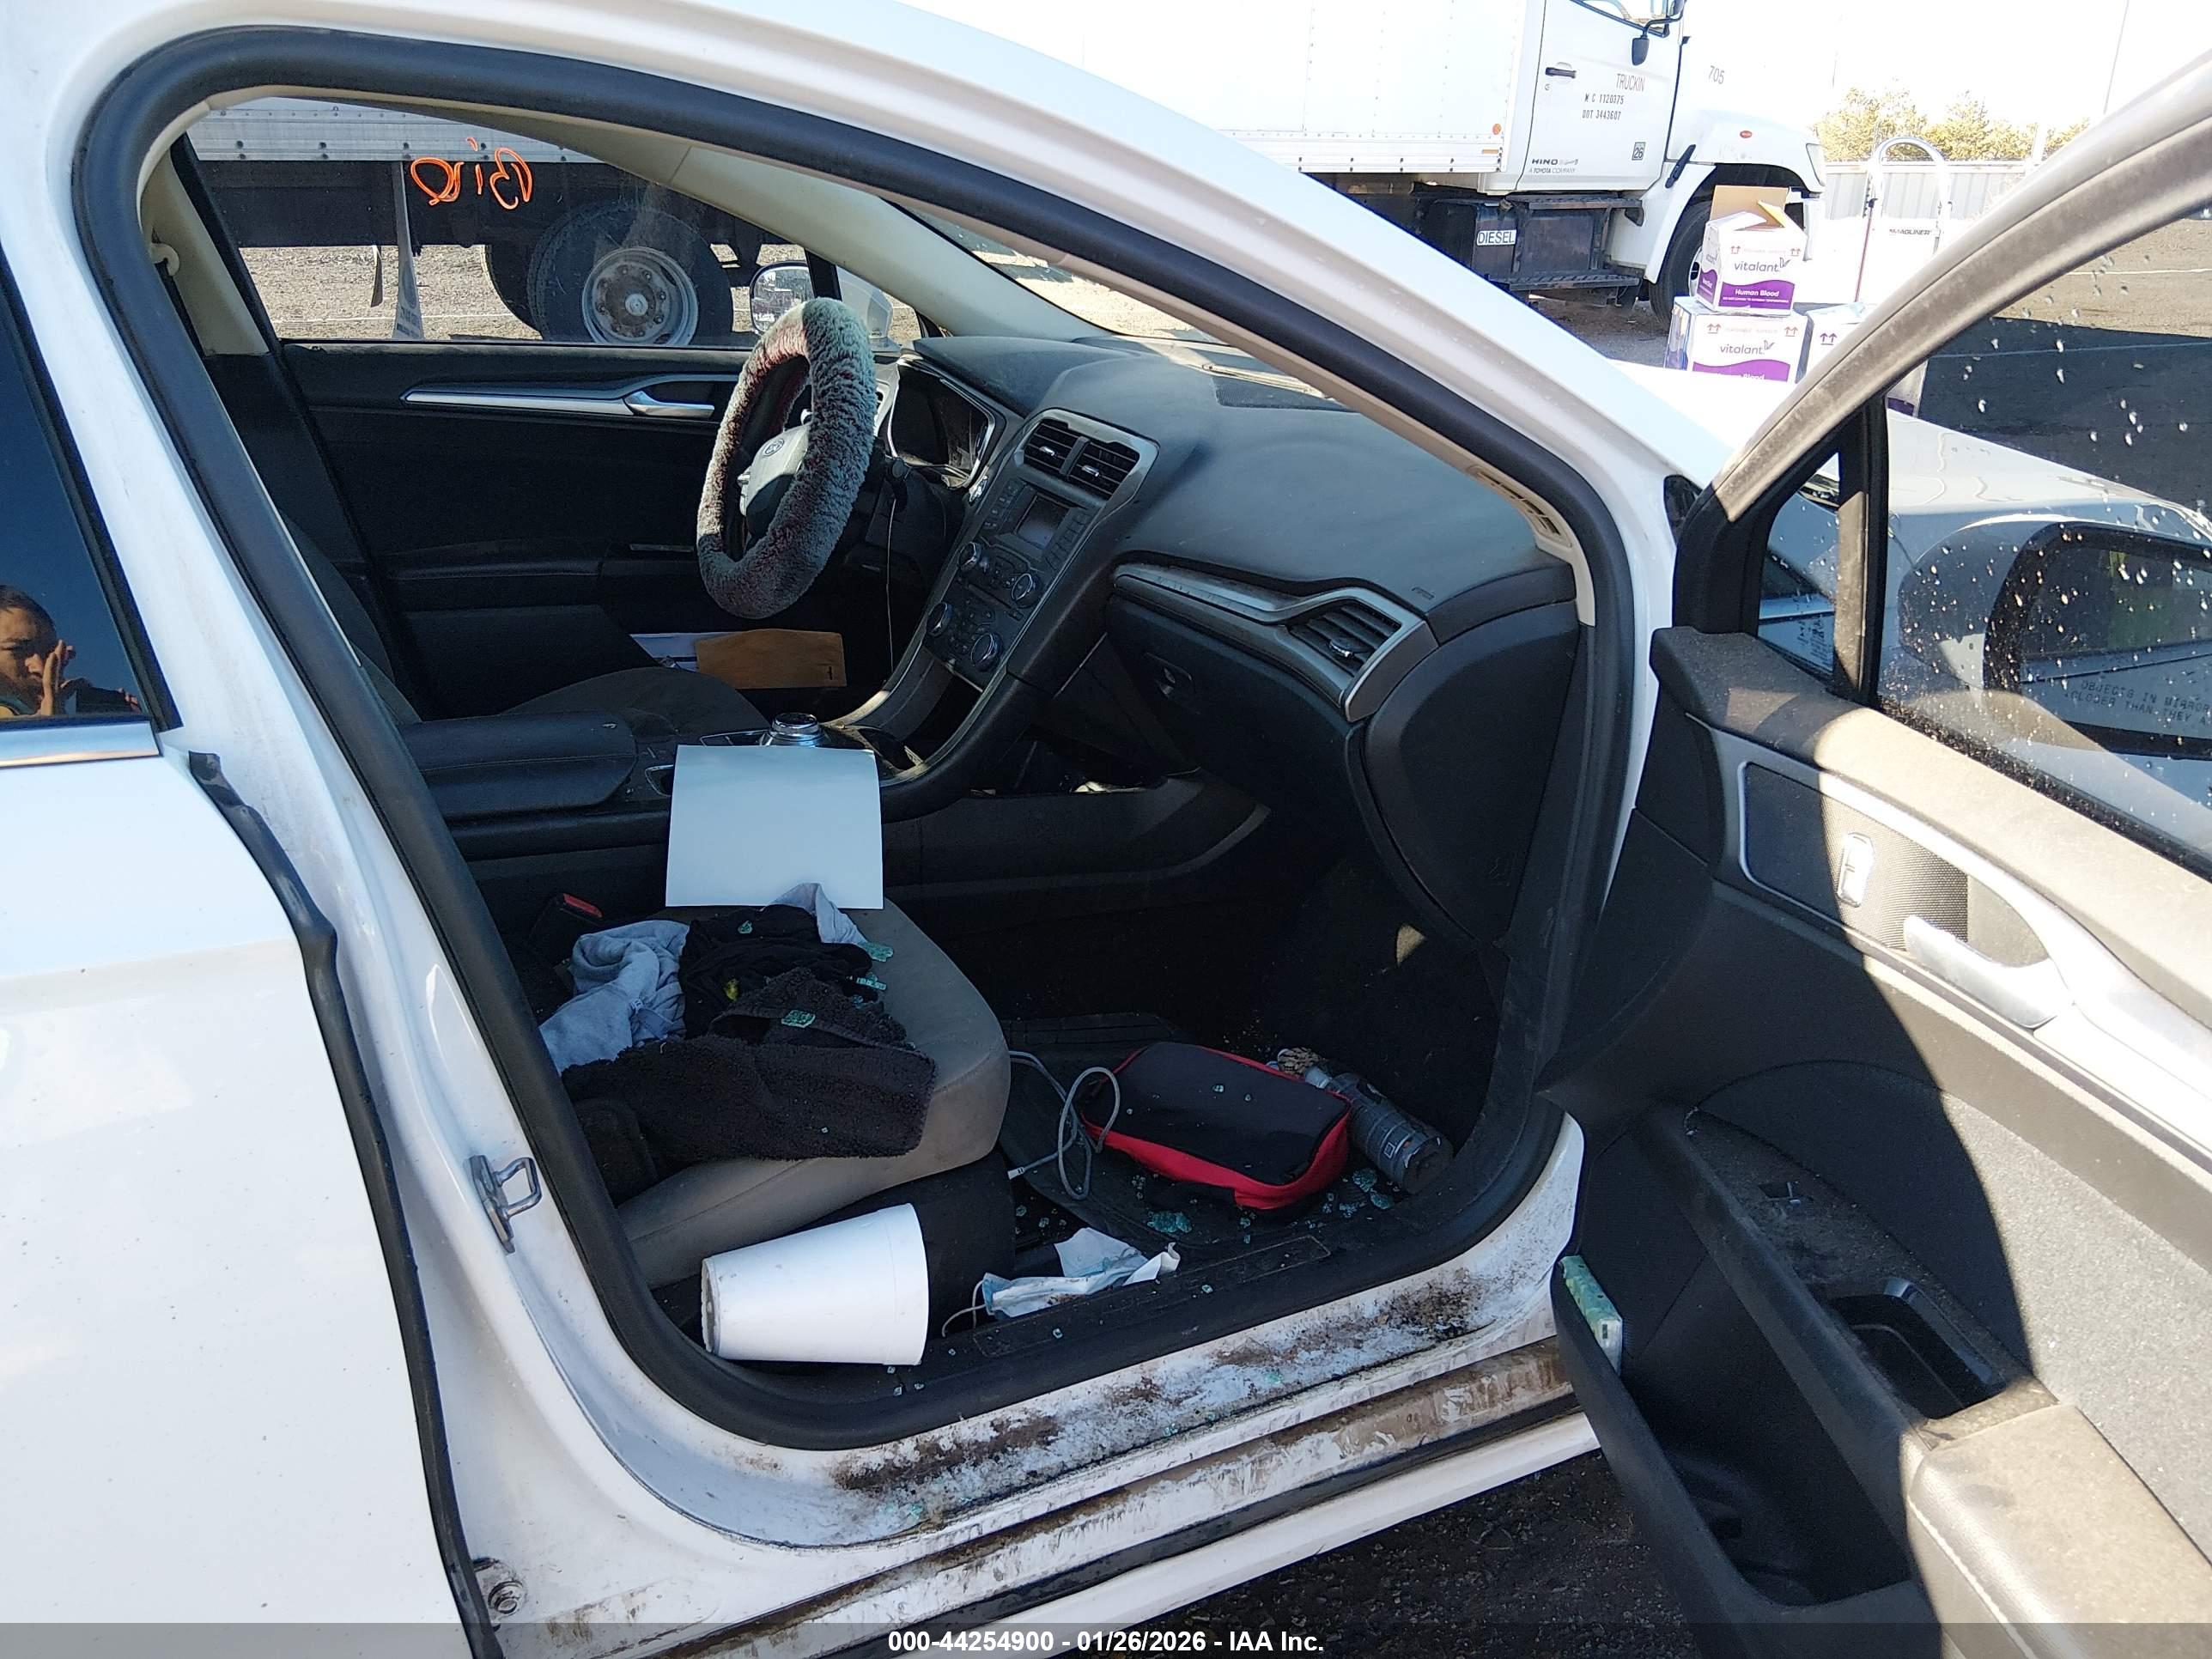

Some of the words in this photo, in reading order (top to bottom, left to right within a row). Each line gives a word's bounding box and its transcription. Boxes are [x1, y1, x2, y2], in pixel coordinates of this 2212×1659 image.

[1708, 65, 1725, 84] 705
[1616, 73, 1646, 92] TRUCKIN
[1633, 146, 1644, 159] 26
[1478, 231, 1514, 244] DIESEL
[1734, 258, 1780, 273] vitalant
[1735, 289, 1759, 297] Human
[1719, 341, 1765, 356] vitalant
[2081, 679, 2136, 699] OBJECTS
[2142, 692, 2158, 704] IN
[2163, 695, 2211, 714] MIRROR
[2124, 700, 2154, 715] THAN
[2162, 707, 2192, 723] THEY
